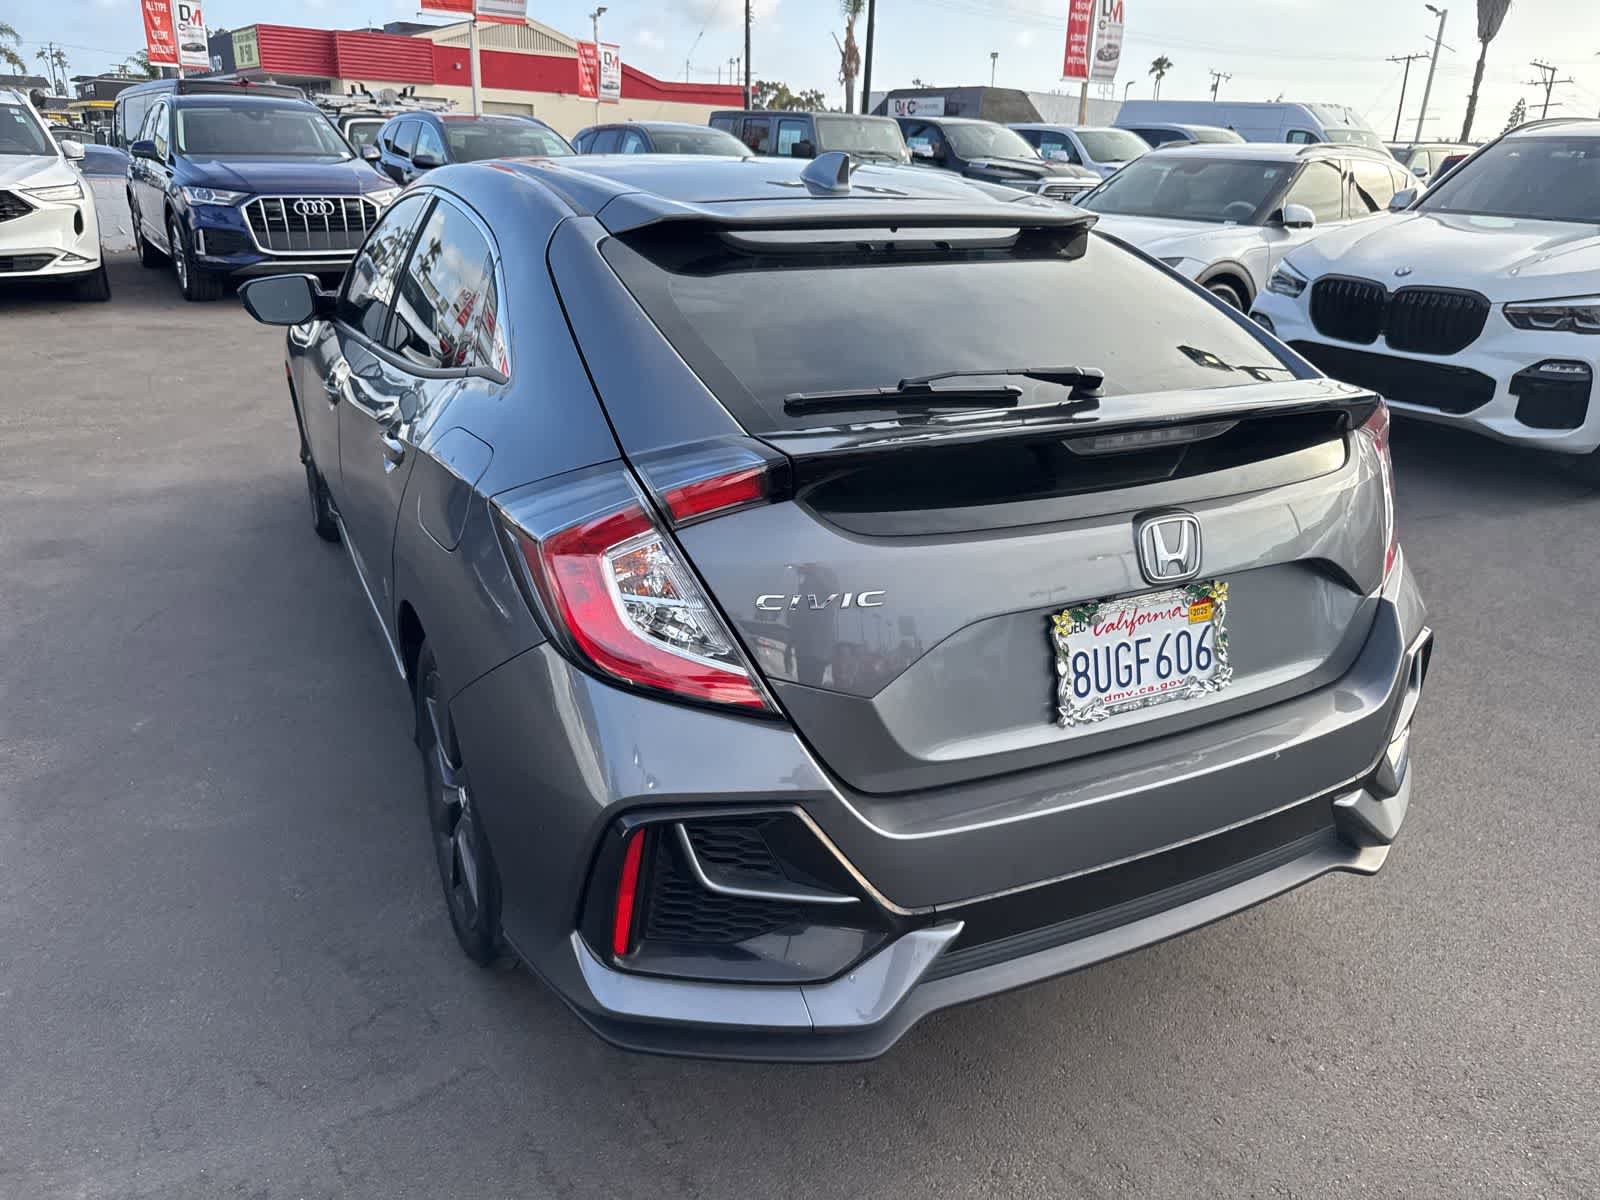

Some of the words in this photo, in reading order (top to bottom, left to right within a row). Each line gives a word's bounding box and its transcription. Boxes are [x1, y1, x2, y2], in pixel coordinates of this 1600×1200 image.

[756, 590, 886, 611] CIVIC
[1093, 606, 1190, 637] California
[1072, 624, 1212, 699] 8UGF606
[1104, 678, 1186, 702] dmv.ca.gov
